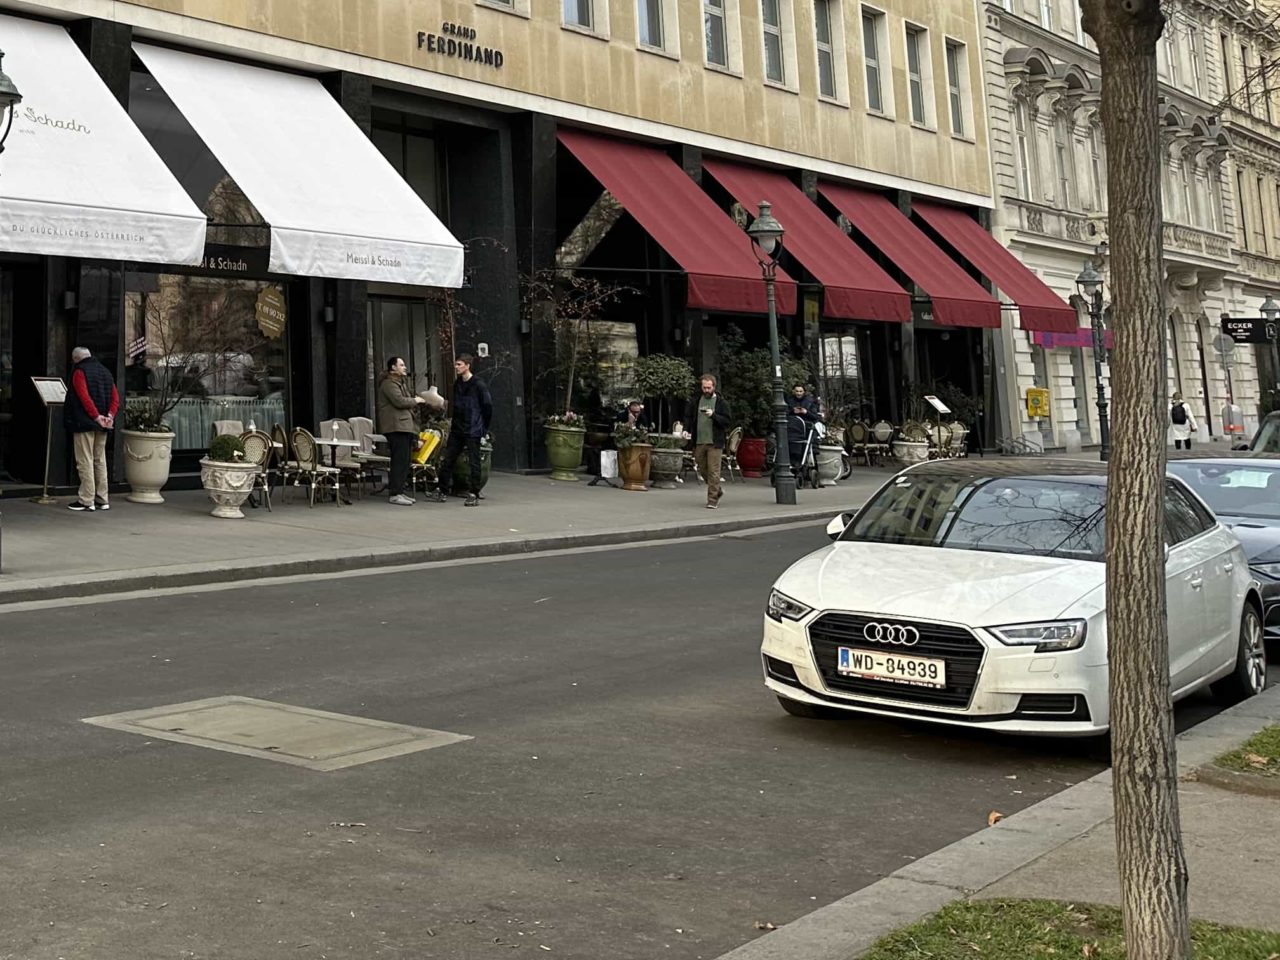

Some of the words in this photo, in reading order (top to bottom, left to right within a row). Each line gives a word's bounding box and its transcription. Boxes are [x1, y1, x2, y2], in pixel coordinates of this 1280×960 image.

[442, 22, 476, 40] GRAND
[417, 31, 504, 68] FERDINAND
[24, 106, 91, 134] Schadn
[12, 224, 24, 232] DU
[30, 224, 89, 238] GLÜCKLICHES
[94, 230, 145, 242] ÖSTERREICH
[209, 258, 216, 269] &
[217, 257, 248, 271] Schadn
[346, 252, 369, 265] Meissl
[371, 255, 376, 265] &
[377, 255, 402, 268] Schadn
